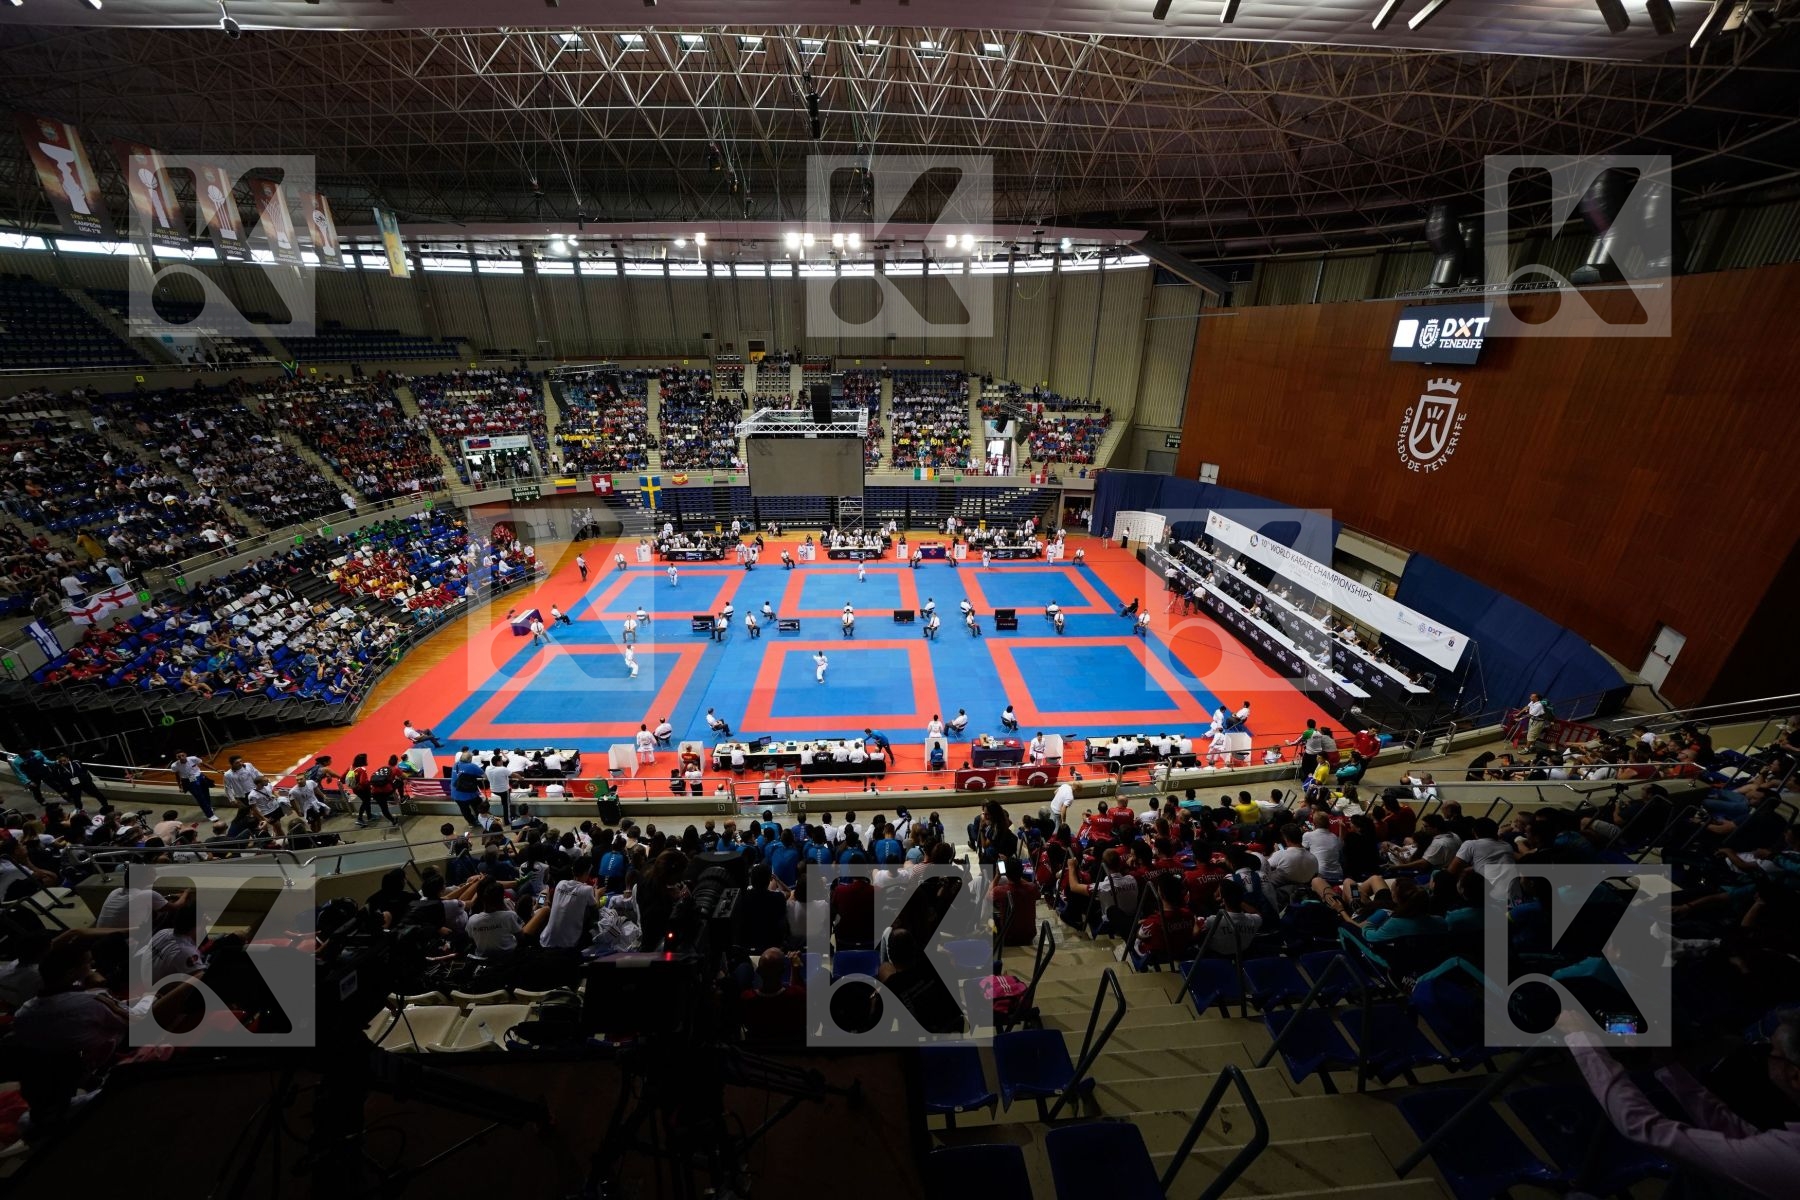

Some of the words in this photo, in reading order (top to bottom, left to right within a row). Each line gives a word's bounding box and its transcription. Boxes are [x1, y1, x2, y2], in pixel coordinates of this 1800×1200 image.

[1439, 338, 1483, 349] TENERIFE
[1441, 317, 1490, 337] DXT
[1397, 406, 1413, 463] CABILDO
[1407, 459, 1421, 473] DE
[1424, 412, 1468, 473] TENERIFE
[1270, 543, 1291, 559] WORLD
[1291, 554, 1313, 571] KARATE
[1313, 565, 1373, 602] CHAMPIONSHIPS
